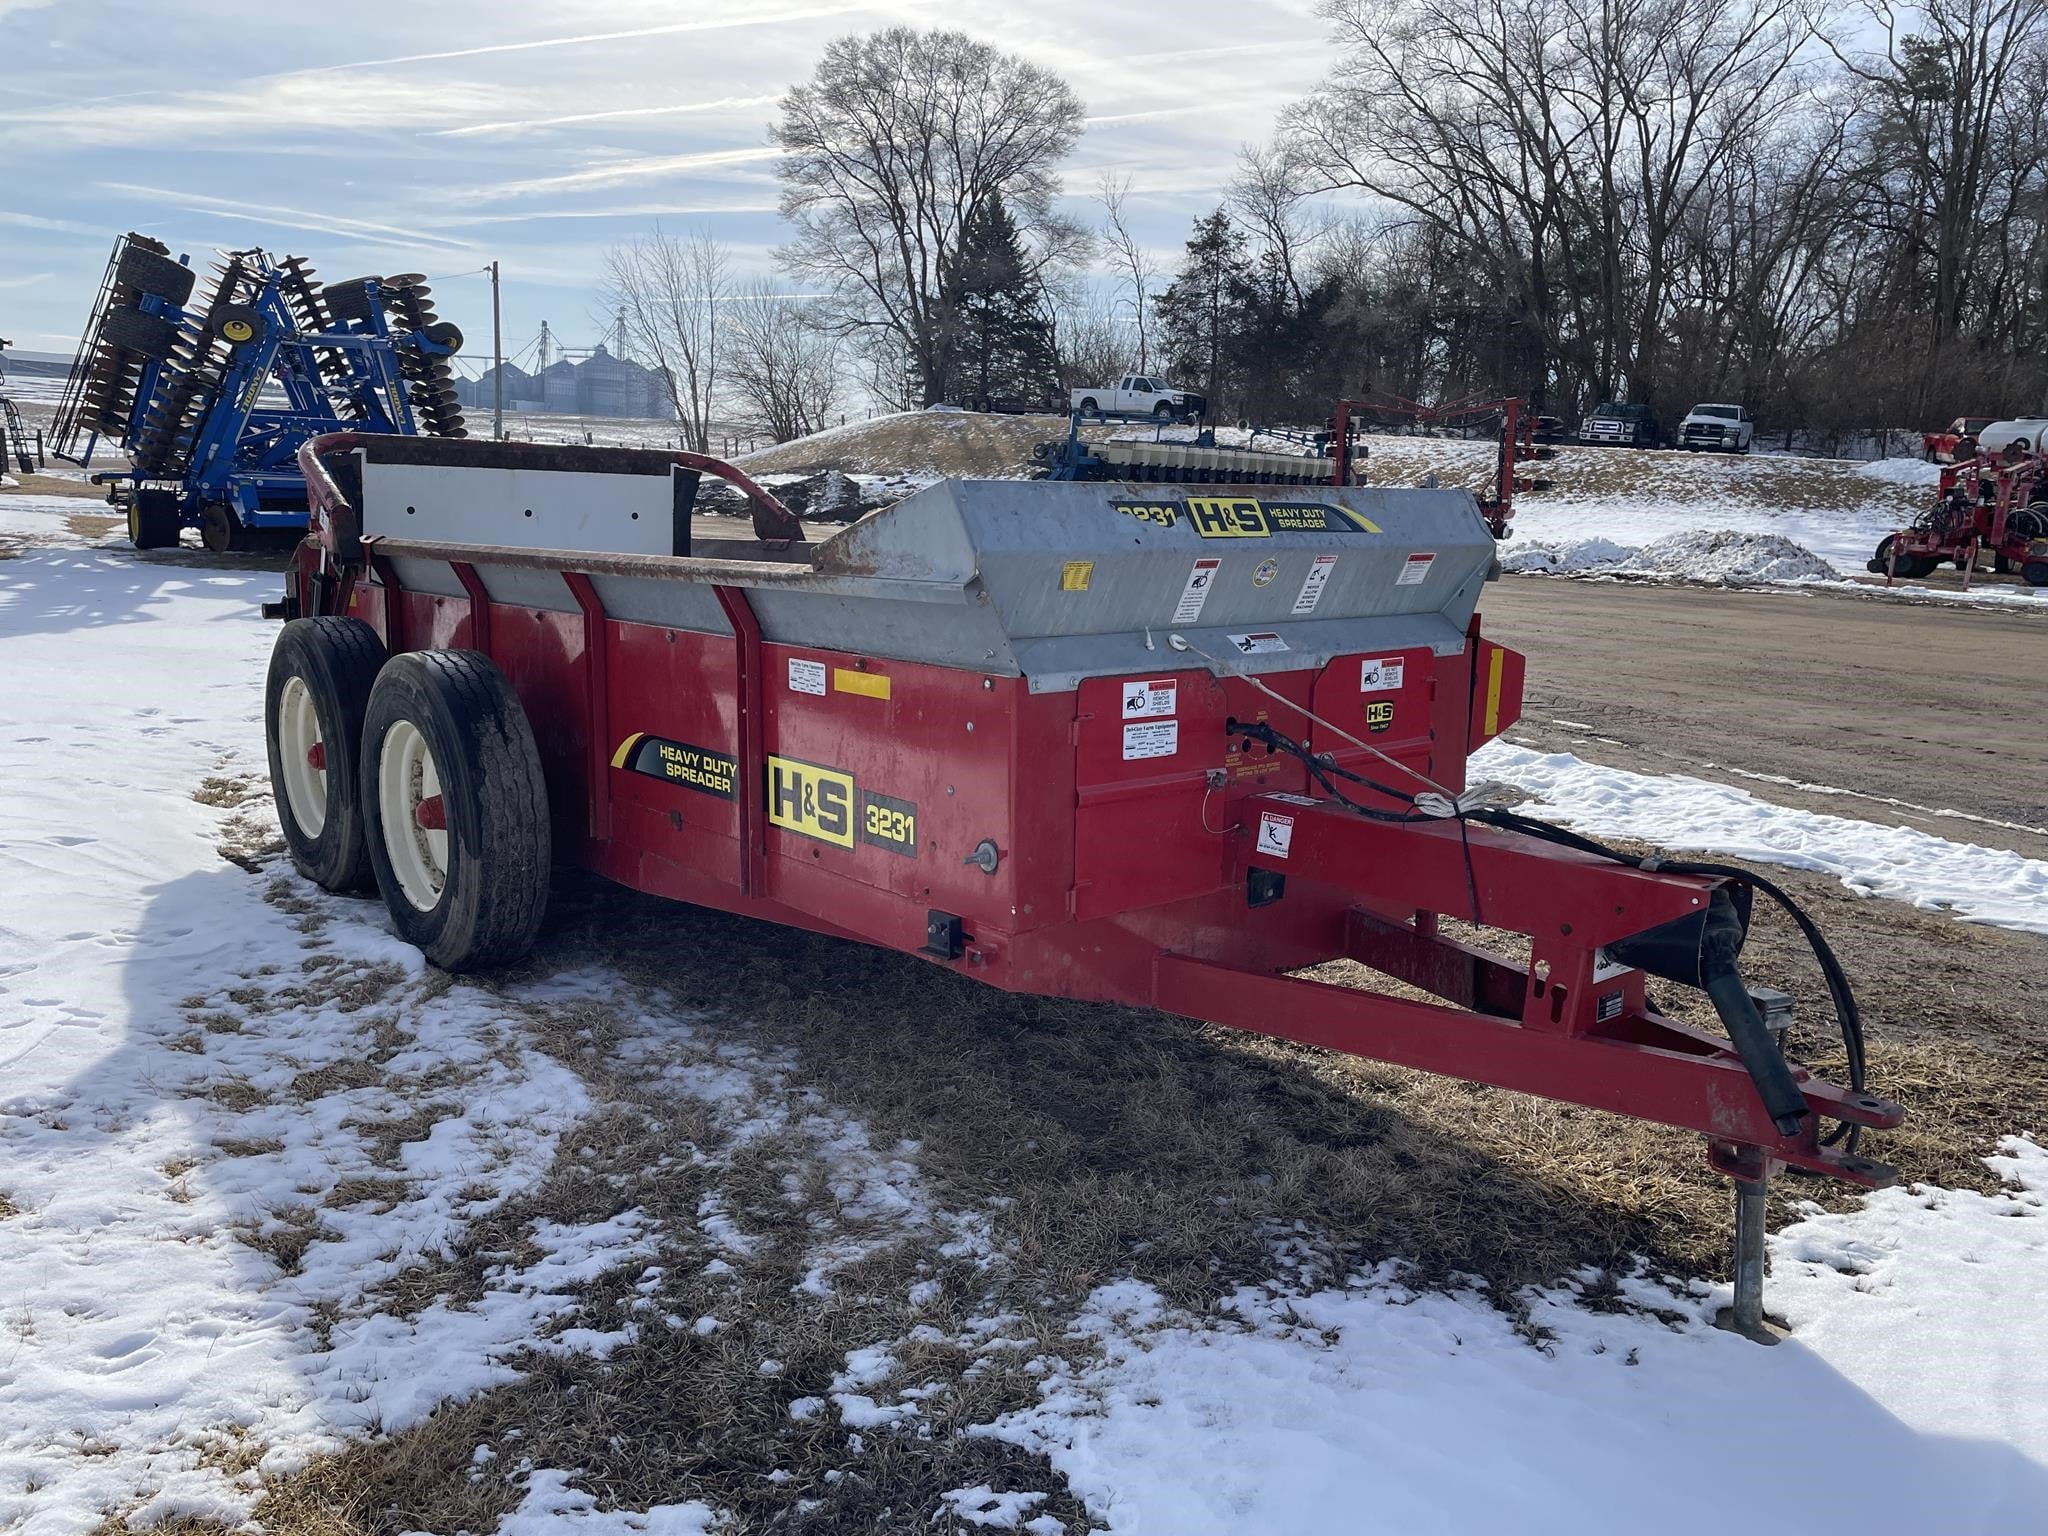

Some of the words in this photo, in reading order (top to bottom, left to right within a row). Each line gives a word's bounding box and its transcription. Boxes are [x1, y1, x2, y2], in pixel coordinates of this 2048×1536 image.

[1194, 502, 1264, 532] H&S
[1269, 508, 1300, 519] HEAVY
[1303, 508, 1326, 519] DUTY
[1279, 519, 1327, 529] SPREADER
[1368, 704, 1393, 721] H&S
[660, 744, 700, 767] HEAVY
[703, 756, 738, 778] DUTY
[666, 762, 732, 793] SPREADER
[773, 766, 848, 837] H&S
[866, 804, 915, 846] 3231
[1269, 815, 1292, 825] DANGER
